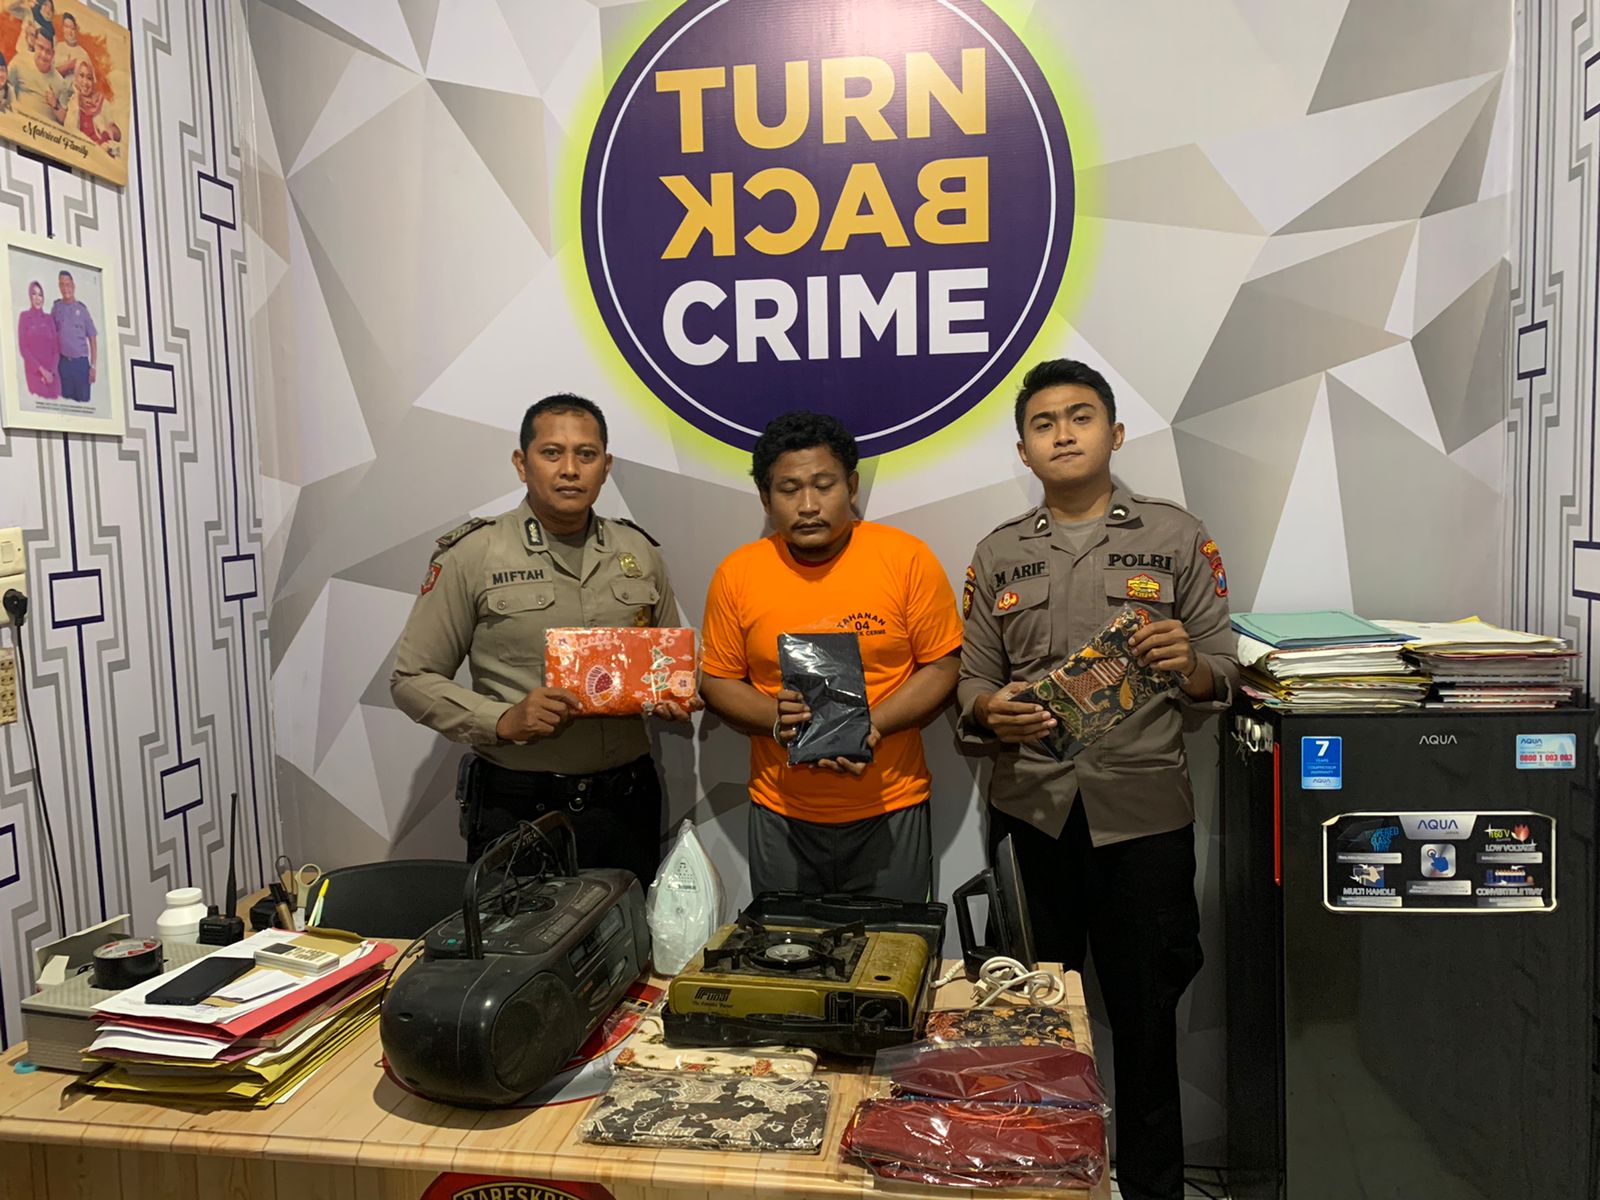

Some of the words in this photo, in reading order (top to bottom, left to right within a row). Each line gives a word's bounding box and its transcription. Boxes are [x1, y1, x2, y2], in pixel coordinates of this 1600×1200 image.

[655, 47, 987, 154] TURN
[662, 267, 990, 367] CRIME
[1108, 553, 1173, 570] POLRI
[492, 568, 545, 586] MIFTAH
[994, 570, 1007, 588] M
[1010, 560, 1046, 581] ARIF
[836, 611, 887, 629] TAHANAN
[854, 620, 870, 632] 04
[1418, 734, 1458, 745] AQUA
[1315, 740, 1330, 757] 7
[1417, 819, 1459, 830] AQUA
[1485, 844, 1503, 852] LOW
[1343, 887, 1365, 896] MULTI
[1366, 888, 1396, 896] HANDLE
